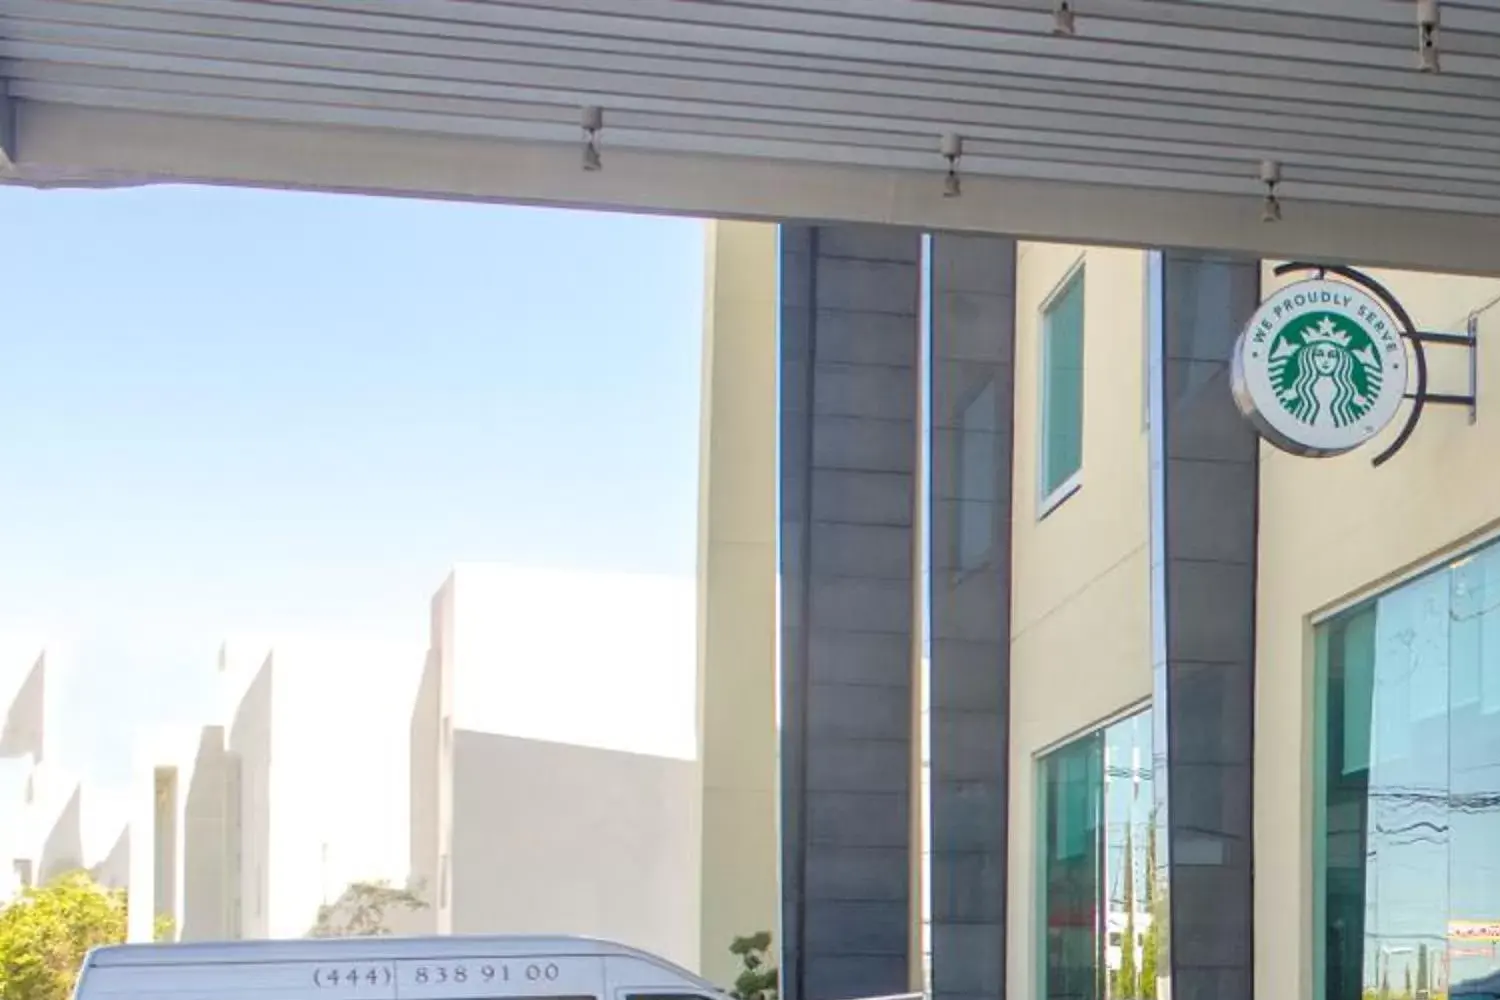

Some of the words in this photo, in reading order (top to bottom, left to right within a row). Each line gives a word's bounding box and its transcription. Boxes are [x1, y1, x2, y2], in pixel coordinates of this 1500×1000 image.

[1253, 319, 1273, 343] WE
[1273, 291, 1353, 318] PROUDLY
[1357, 304, 1397, 352] SERVE
[313, 967, 392, 987] (444)
[415, 966, 468, 984] 838
[481, 964, 510, 982] 91
[525, 963, 559, 981] 00
